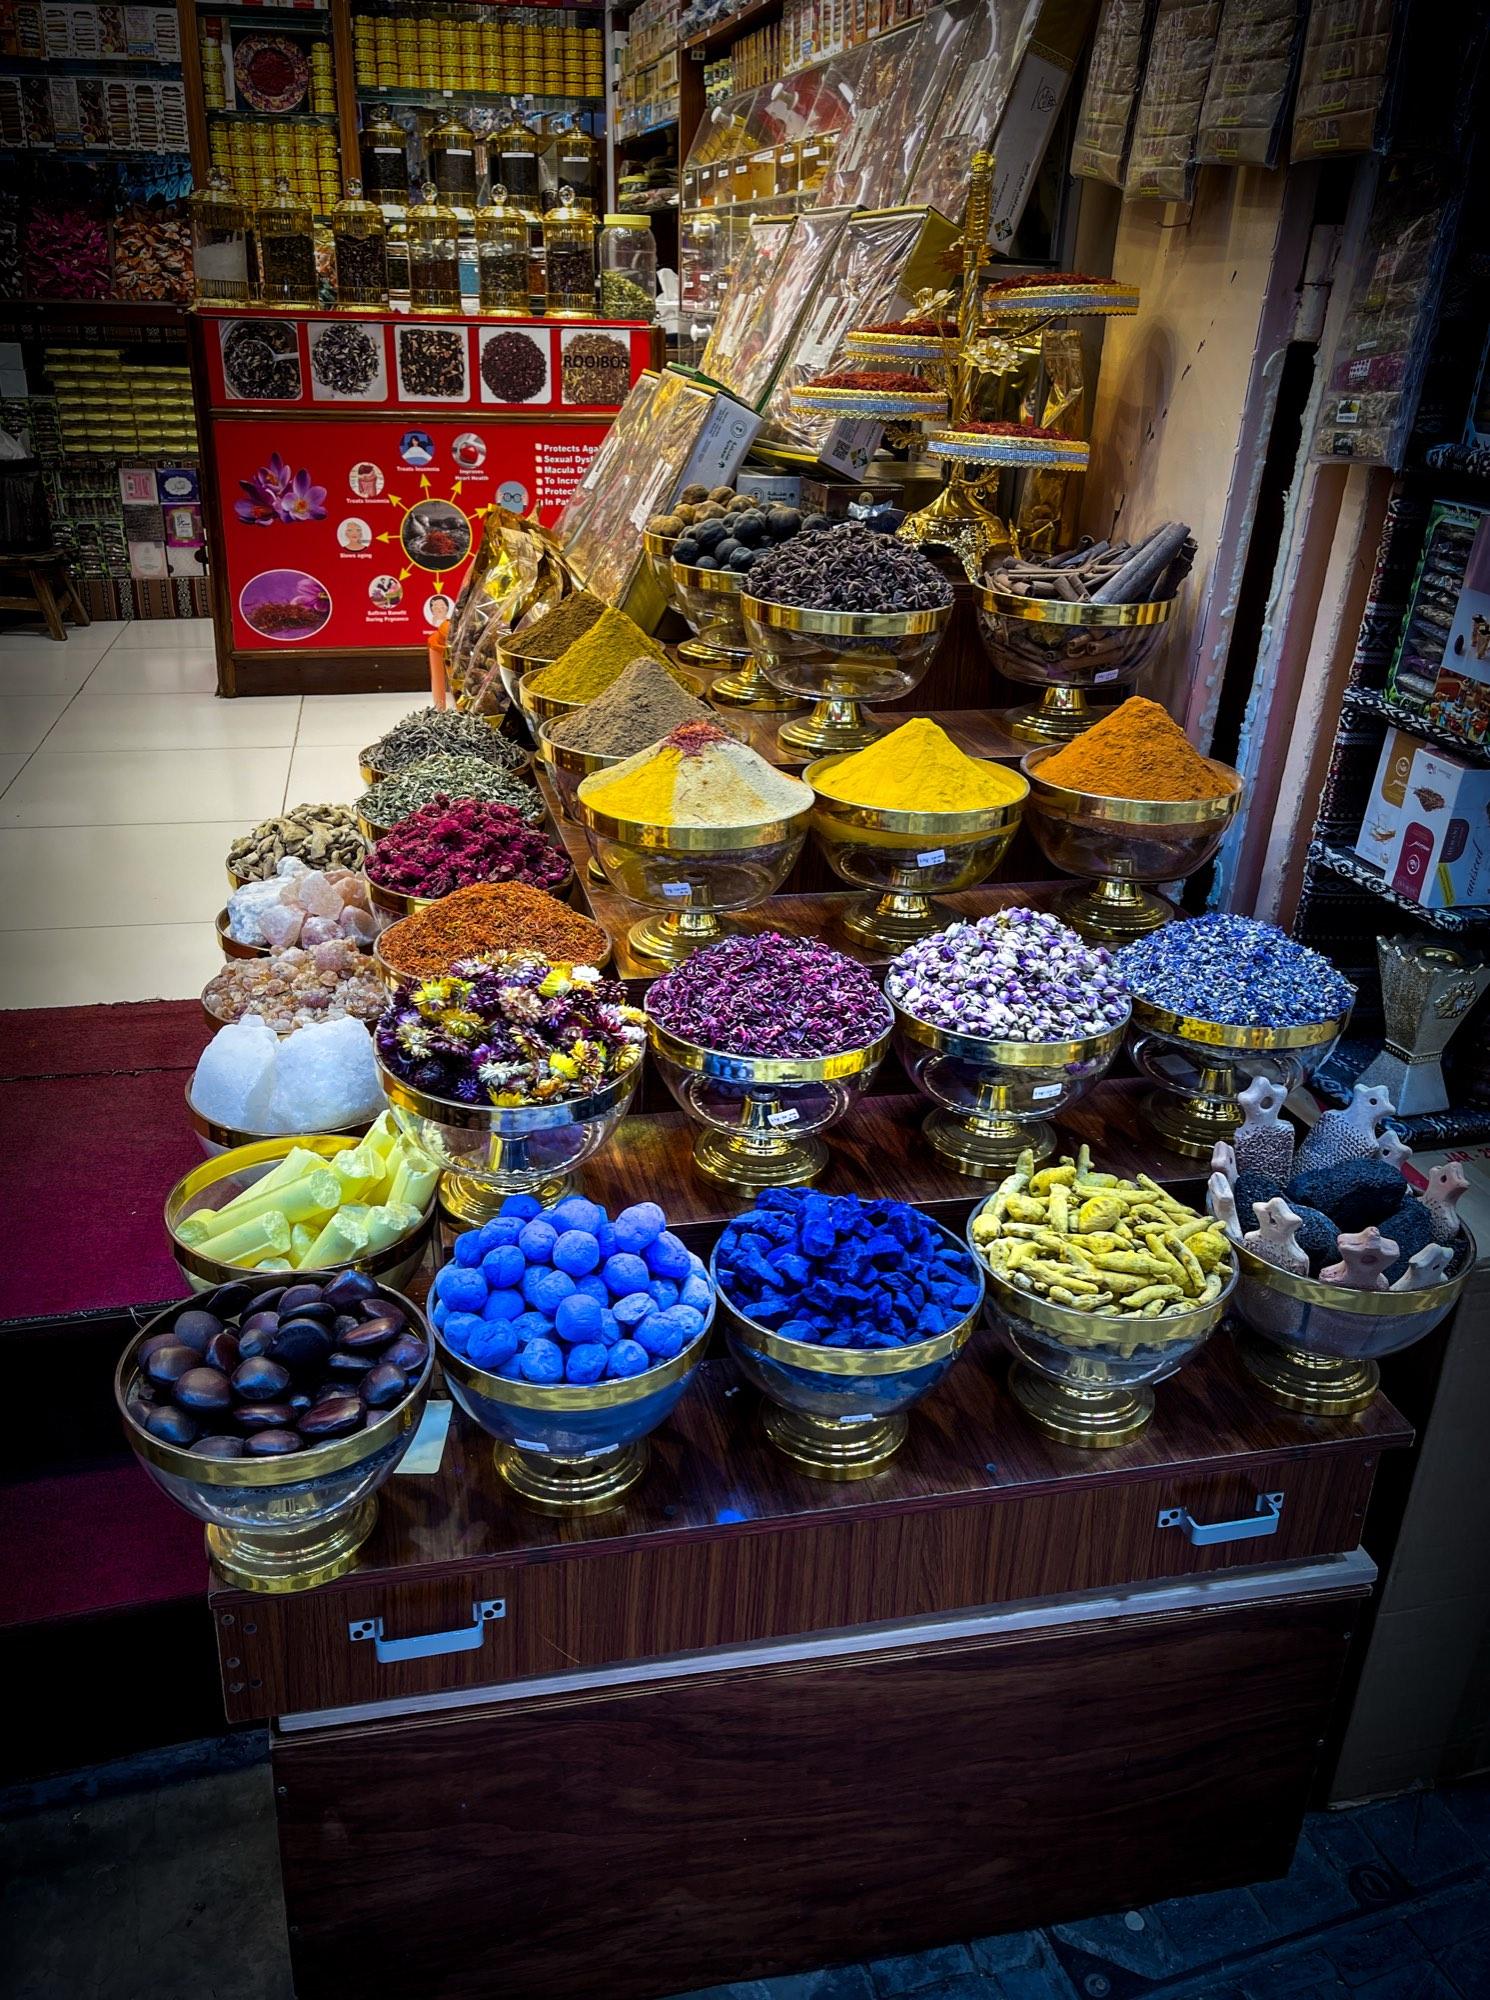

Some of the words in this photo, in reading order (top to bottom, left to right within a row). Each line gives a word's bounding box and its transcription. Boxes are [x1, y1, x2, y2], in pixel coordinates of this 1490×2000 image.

[563, 355, 629, 368] ROOIBOS
[543, 445, 580, 453] Protects
[582, 445, 602, 454] Aga
[544, 466, 575, 474] Macula
[544, 476, 555, 485] To
[556, 477, 581, 485] Incre
[544, 498, 554, 506] In
